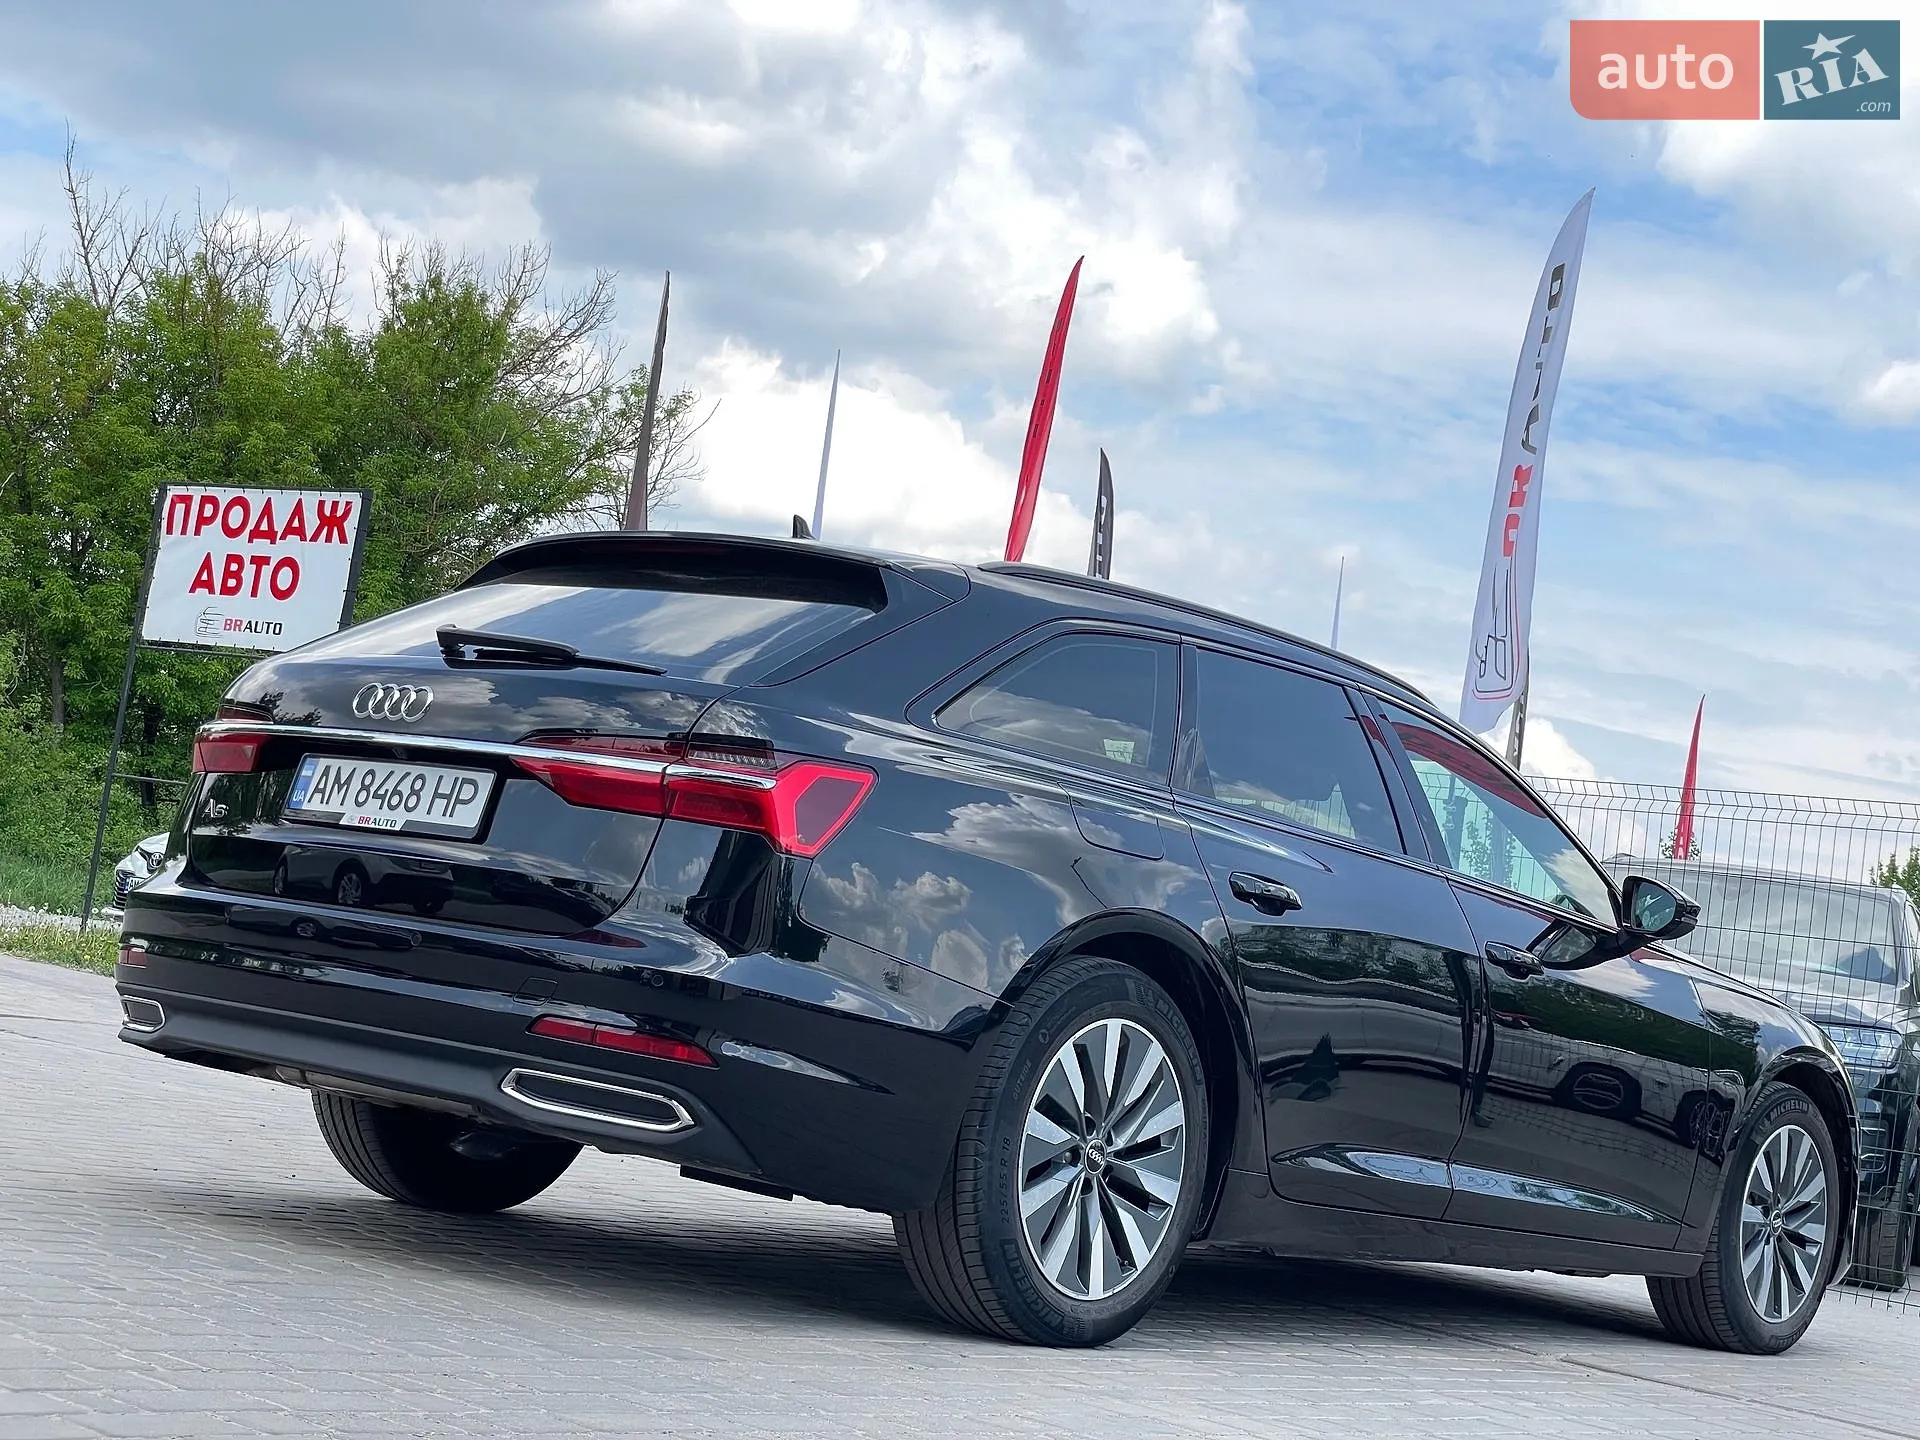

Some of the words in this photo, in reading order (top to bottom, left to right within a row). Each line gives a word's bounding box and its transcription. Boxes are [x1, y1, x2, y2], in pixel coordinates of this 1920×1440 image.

[165, 494, 354, 545] ПРОДАЖ
[188, 551, 301, 601] АВТО
[223, 618, 283, 636] BRAUTO
[292, 789, 305, 802] UA
[307, 763, 357, 806] AM
[354, 768, 428, 814] 8468
[426, 774, 480, 818] HP
[356, 815, 398, 829] BRAUTO
[1769, 1099, 1809, 1122] MICHELIN
[999, 1157, 1009, 1168] R
[999, 1171, 1011, 1224] 225/55
